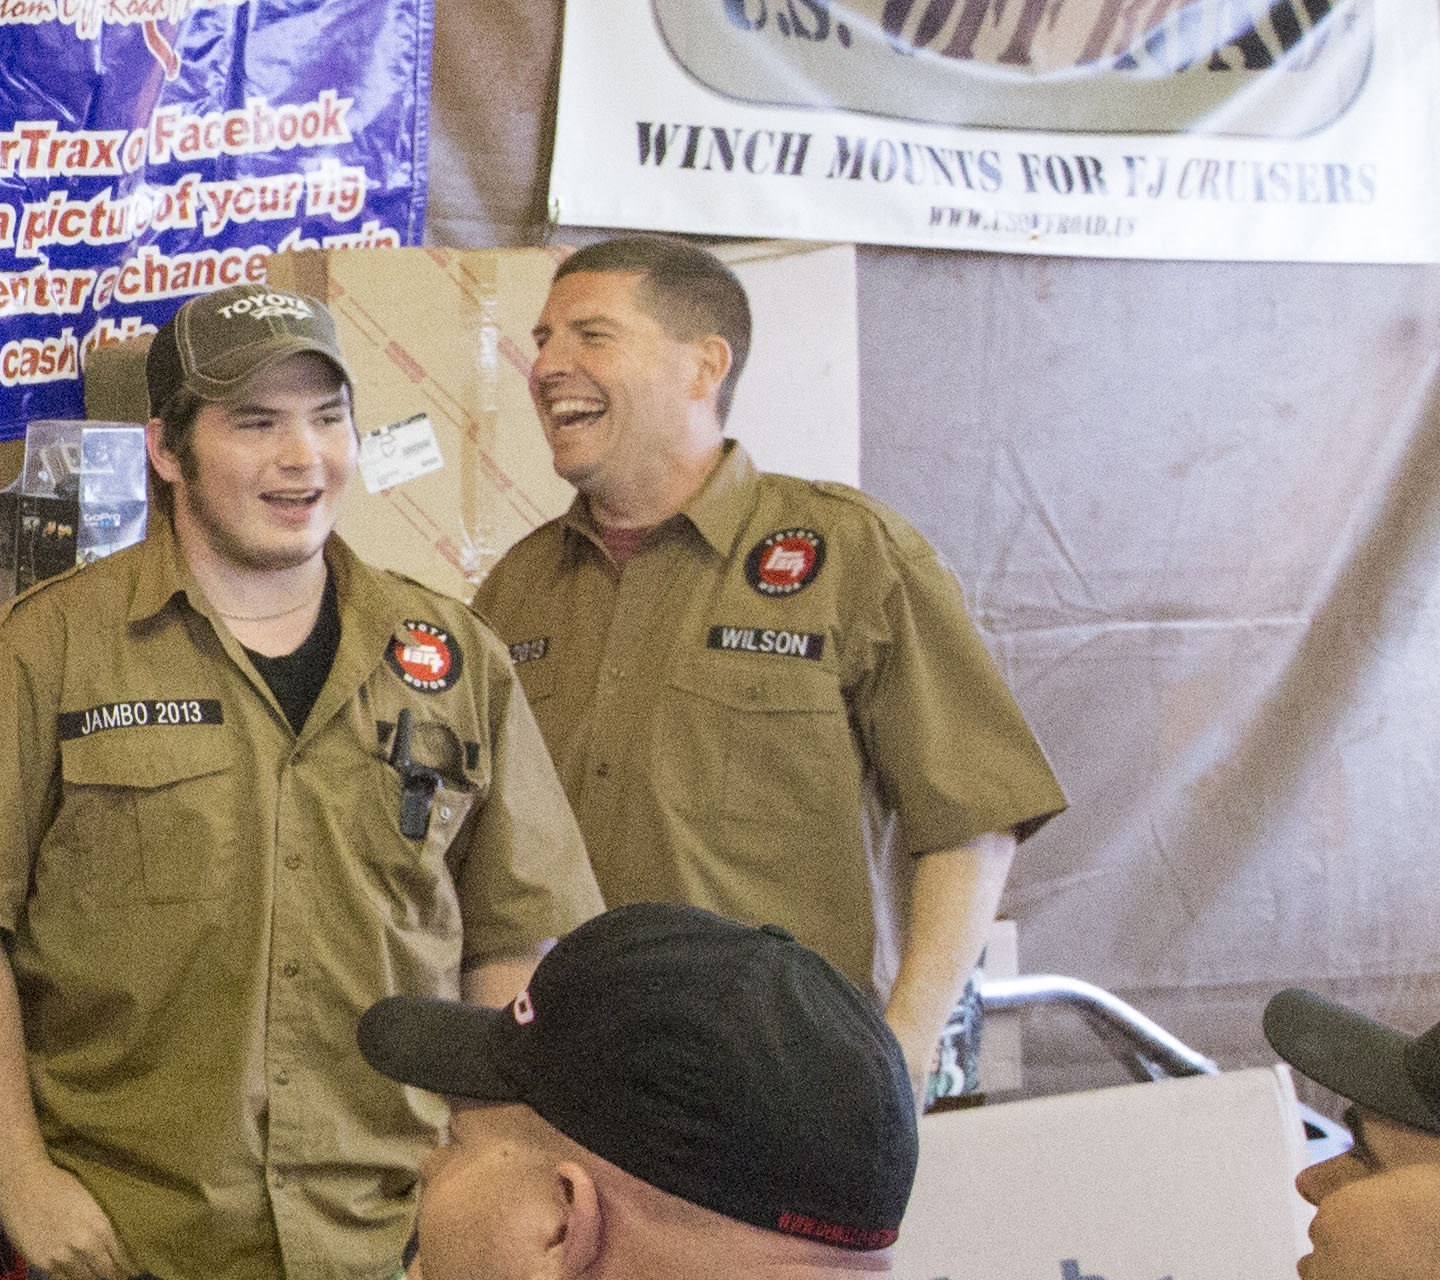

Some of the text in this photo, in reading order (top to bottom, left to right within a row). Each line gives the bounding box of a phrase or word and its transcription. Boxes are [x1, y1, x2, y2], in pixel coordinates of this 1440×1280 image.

[153, 96, 344, 158] Facebook
[636, 121, 812, 177] WINCH
[827, 135, 1003, 193] MOUNTS
[1019, 152, 1110, 196] FOR
[1177, 158, 1378, 204] CRUISERS
[156, 180, 194, 221] of
[207, 181, 299, 228] your
[310, 174, 360, 214] rig
[98, 274, 116, 304] a
[118, 252, 267, 295] chance
[721, 627, 809, 657] WILSON
[81, 700, 203, 736] JAMBO 2013
